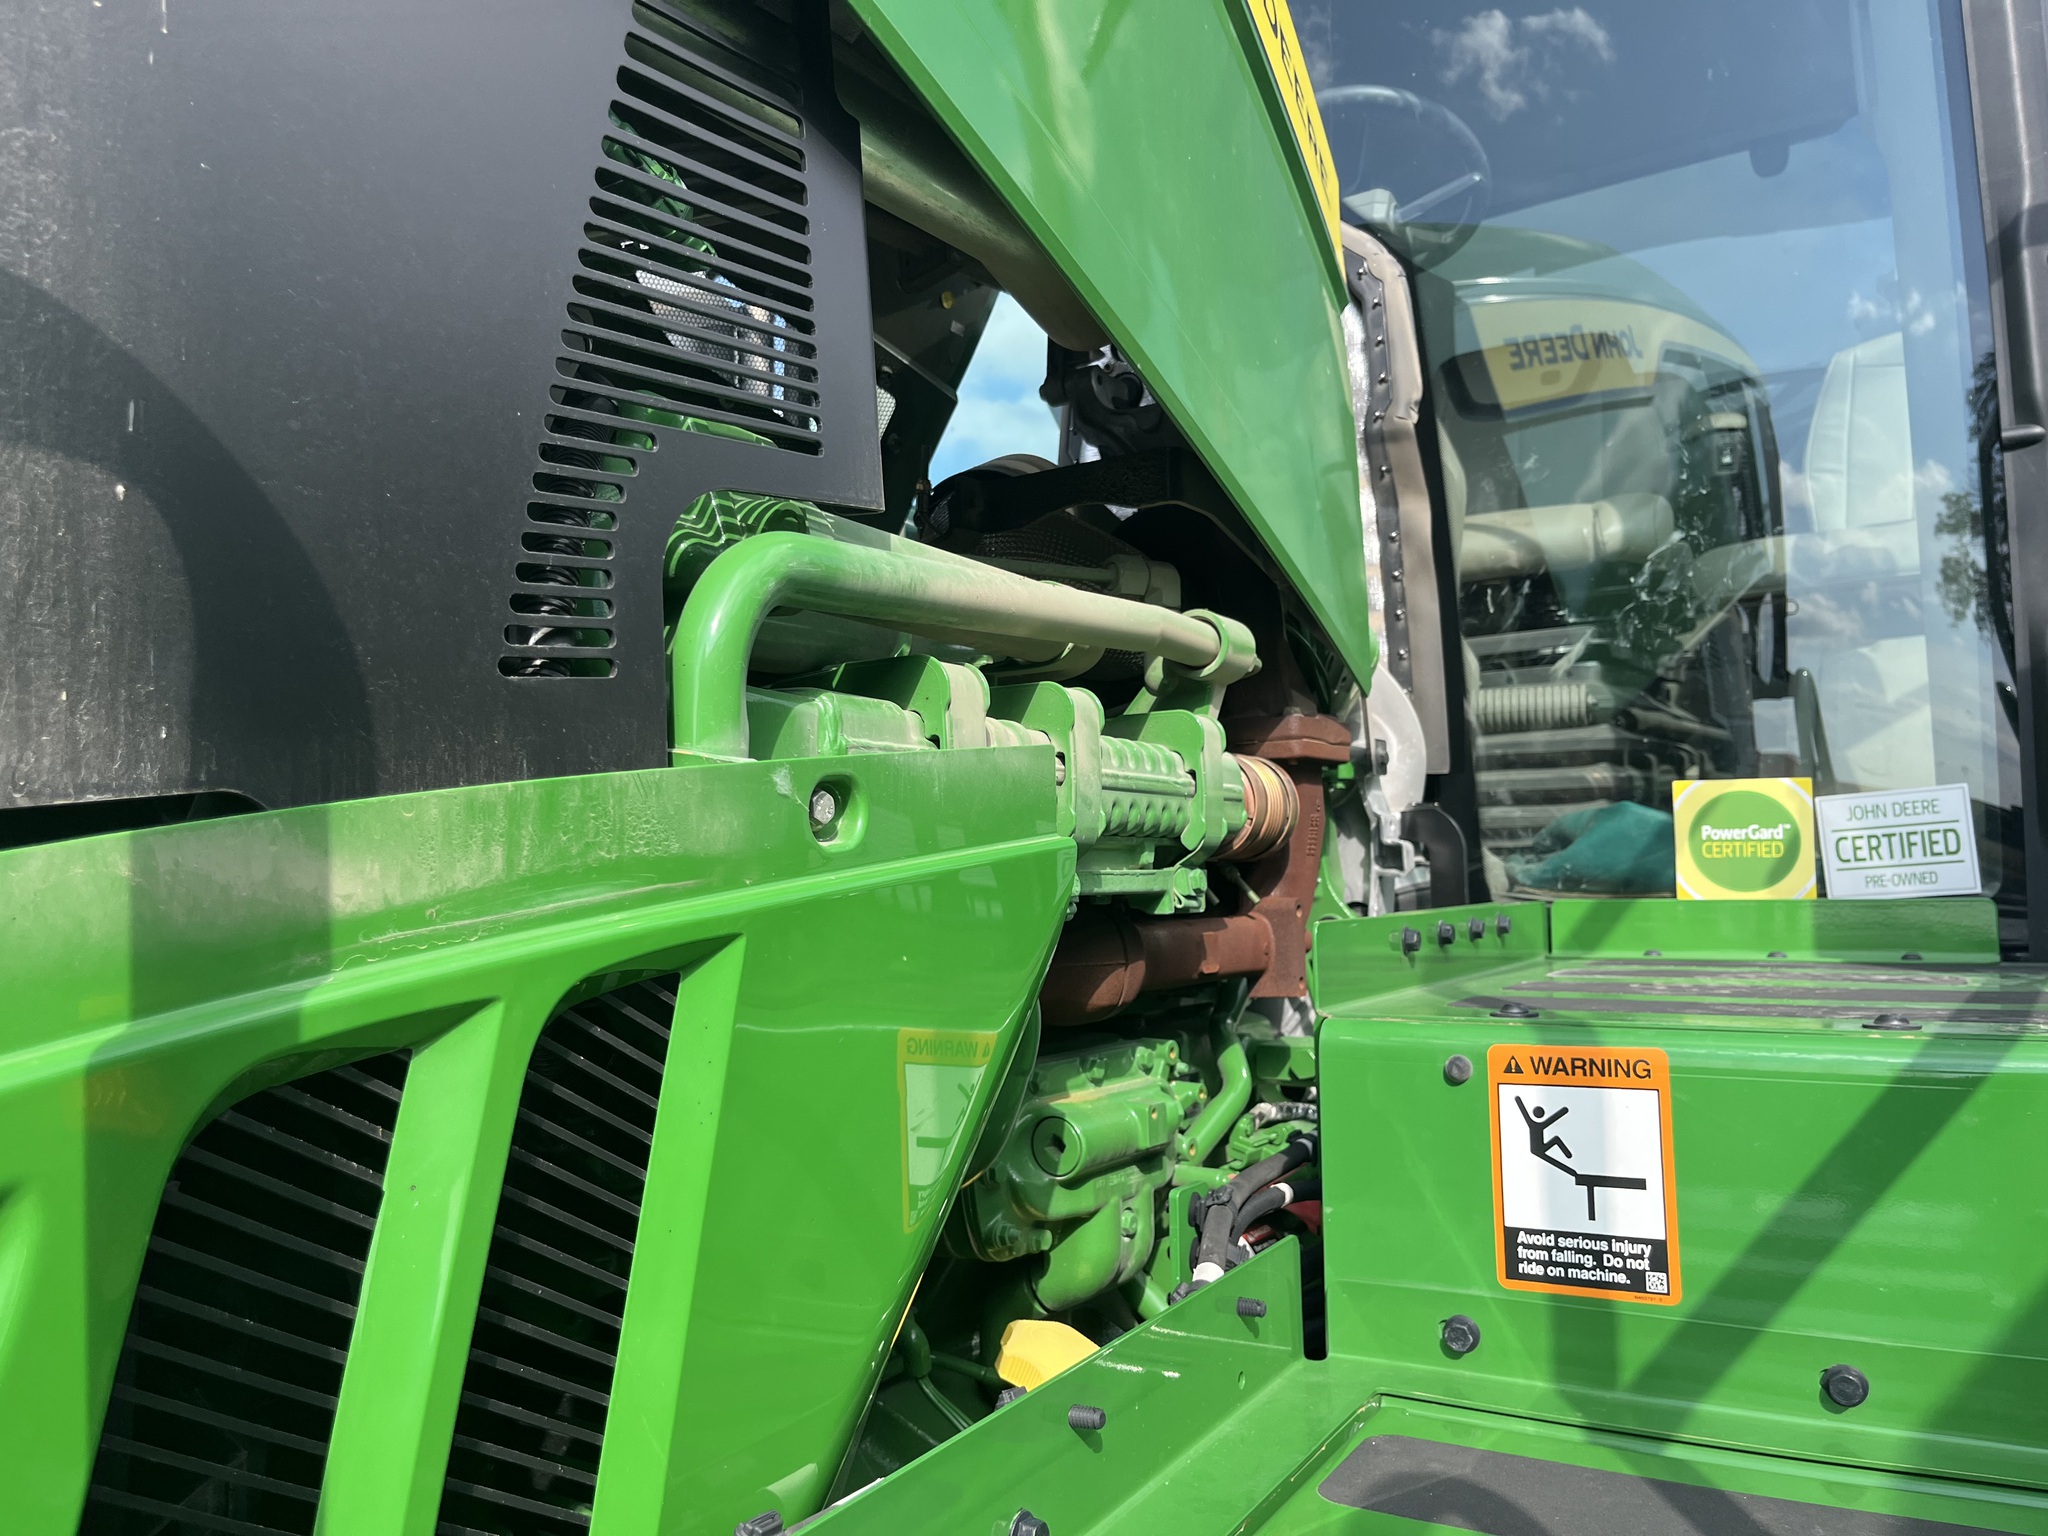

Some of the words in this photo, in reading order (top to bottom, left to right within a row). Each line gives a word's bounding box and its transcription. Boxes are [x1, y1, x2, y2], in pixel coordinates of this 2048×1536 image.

[1846, 803, 1887, 822] JOHN
[1892, 798, 1941, 818] DEERE
[1701, 841, 1785, 858] CERTIFIED
[1835, 828, 1962, 863] CERTIFIED
[1864, 871, 1939, 889] PRE-OWNED
[1529, 1056, 1652, 1080] WARNING
[1517, 1230, 1555, 1247] Avoid
[1557, 1236, 1609, 1252] serious
[1611, 1239, 1652, 1258] injury
[1517, 1246, 1549, 1261] from
[1551, 1249, 1597, 1268] falling.
[1603, 1253, 1624, 1268] Do
[1626, 1257, 1650, 1271] not
[1518, 1261, 1545, 1275] ride
[1546, 1266, 1565, 1277] on
[1567, 1268, 1631, 1285] machine.
